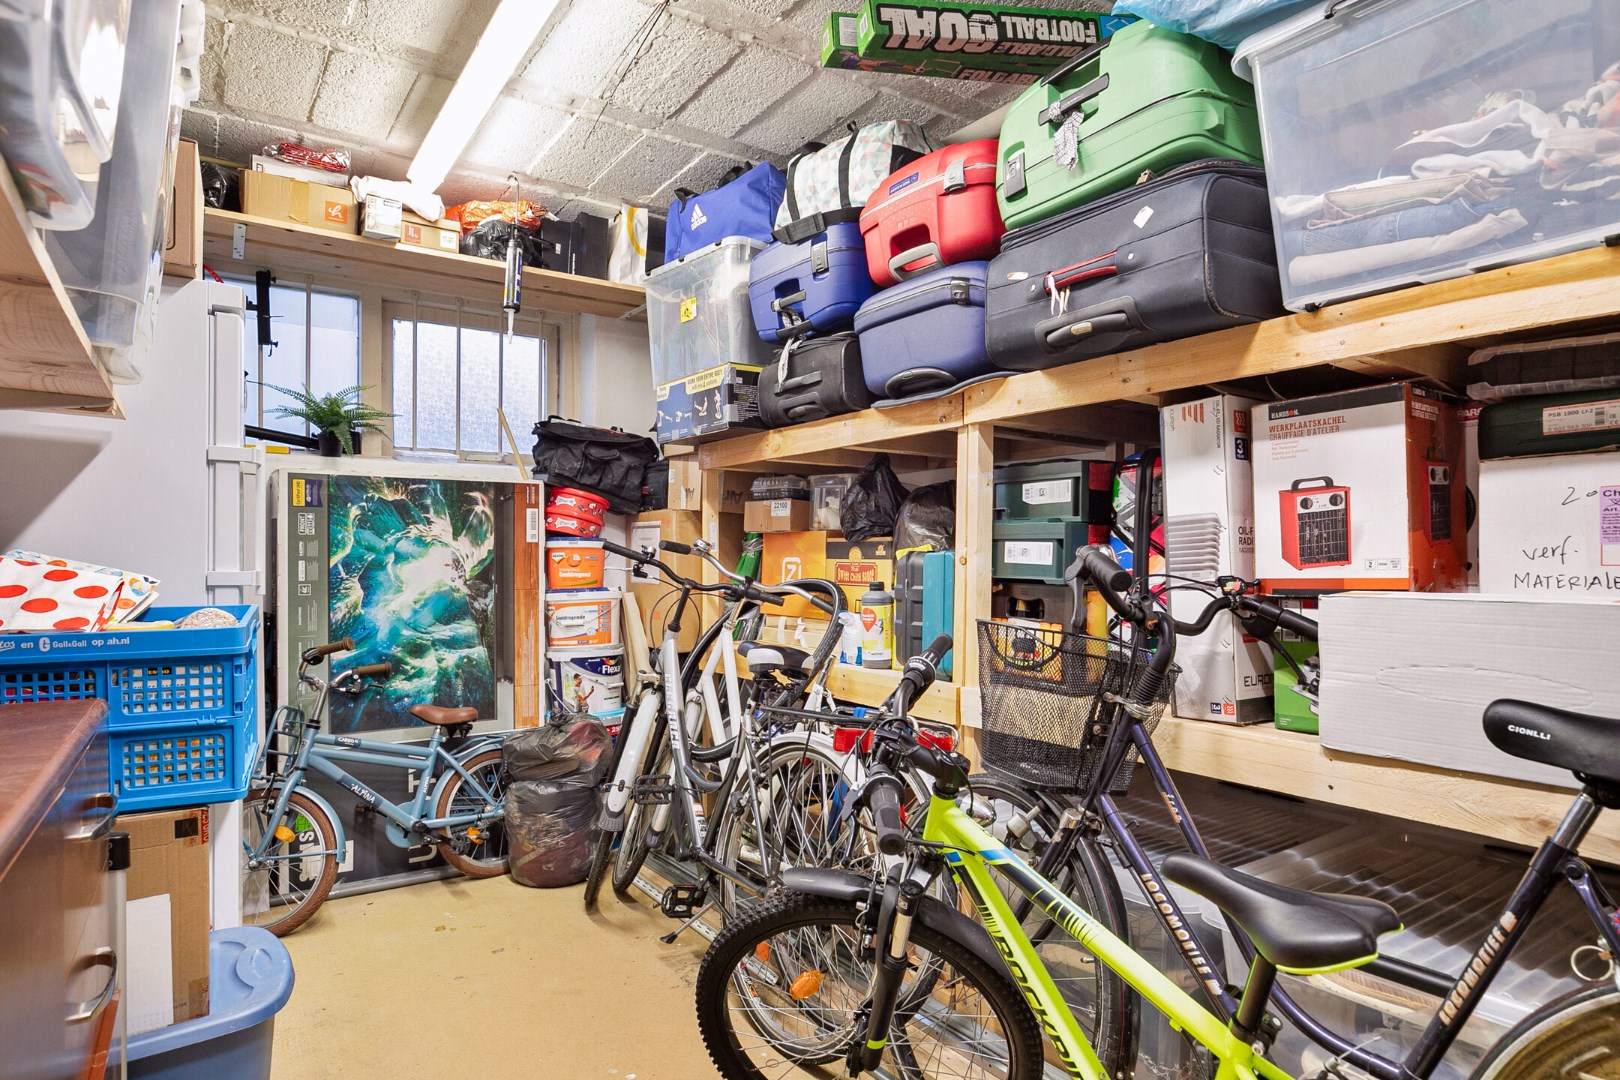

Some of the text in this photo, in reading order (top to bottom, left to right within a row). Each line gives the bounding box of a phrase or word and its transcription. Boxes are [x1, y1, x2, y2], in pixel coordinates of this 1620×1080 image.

[880, 6, 1097, 54] FOOTBALL GOAL
[1269, 416, 1347, 433] WERKPLAATSKACHEL
[1269, 425, 1340, 441] CHAUFFAGE D'ATELIER
[1236, 439, 1244, 454] 3
[773, 501, 788, 509] 22100
[1522, 535, 1578, 566] verf.
[107, 637, 130, 646] ah.nl
[602, 664, 621, 675] Flexa
[1244, 674, 1273, 688] EURO
[1507, 724, 1552, 741] CIONLLI
[1141, 872, 1212, 982] LOCOMOTIEF
[1438, 926, 1507, 1027] LOCOMOTIEF
